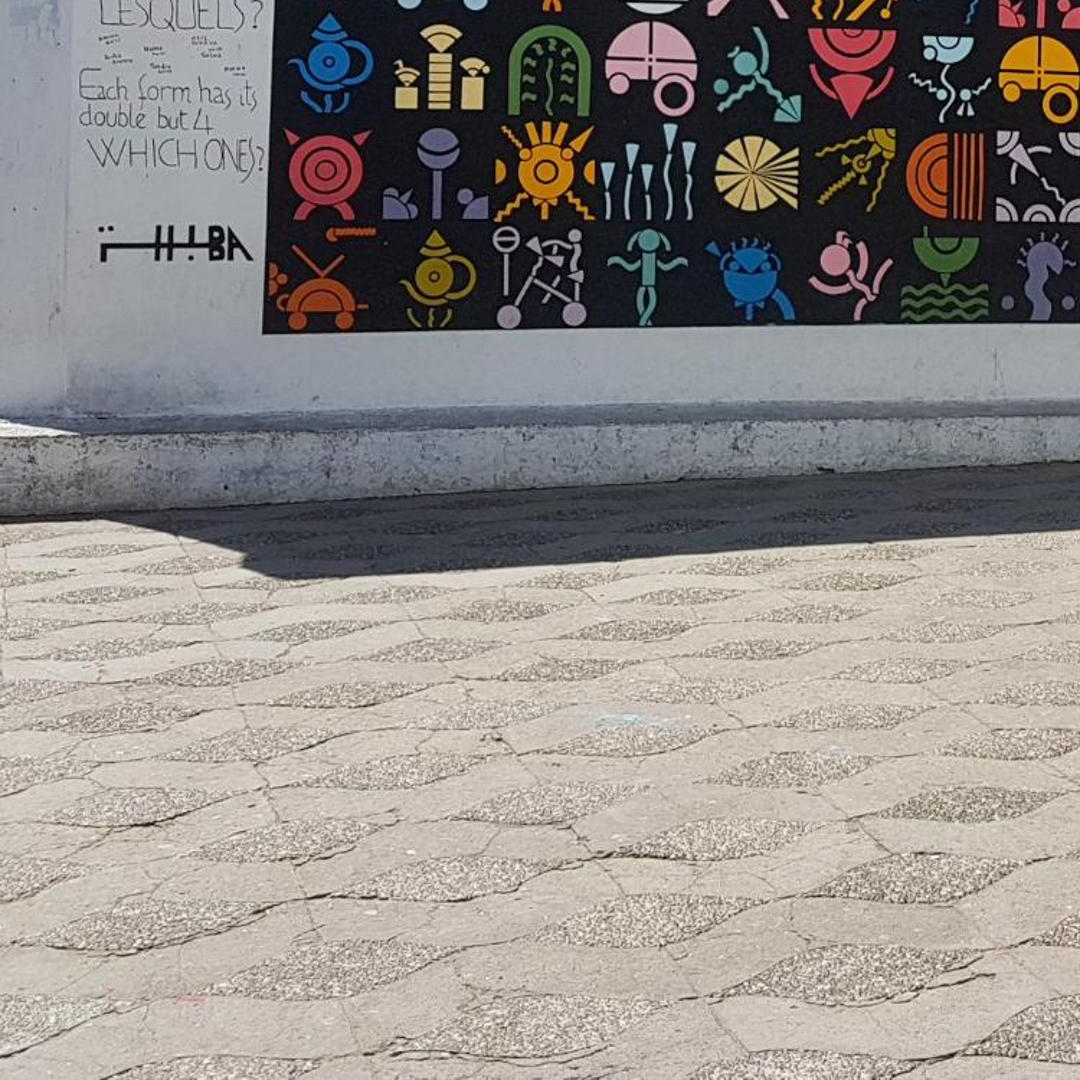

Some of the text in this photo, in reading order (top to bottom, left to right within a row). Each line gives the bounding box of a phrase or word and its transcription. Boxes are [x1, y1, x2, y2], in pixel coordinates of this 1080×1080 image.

[79, 68, 257, 112] Each form has its
[79, 103, 214, 135] double but 4
[87, 136, 198, 169] WHICH
